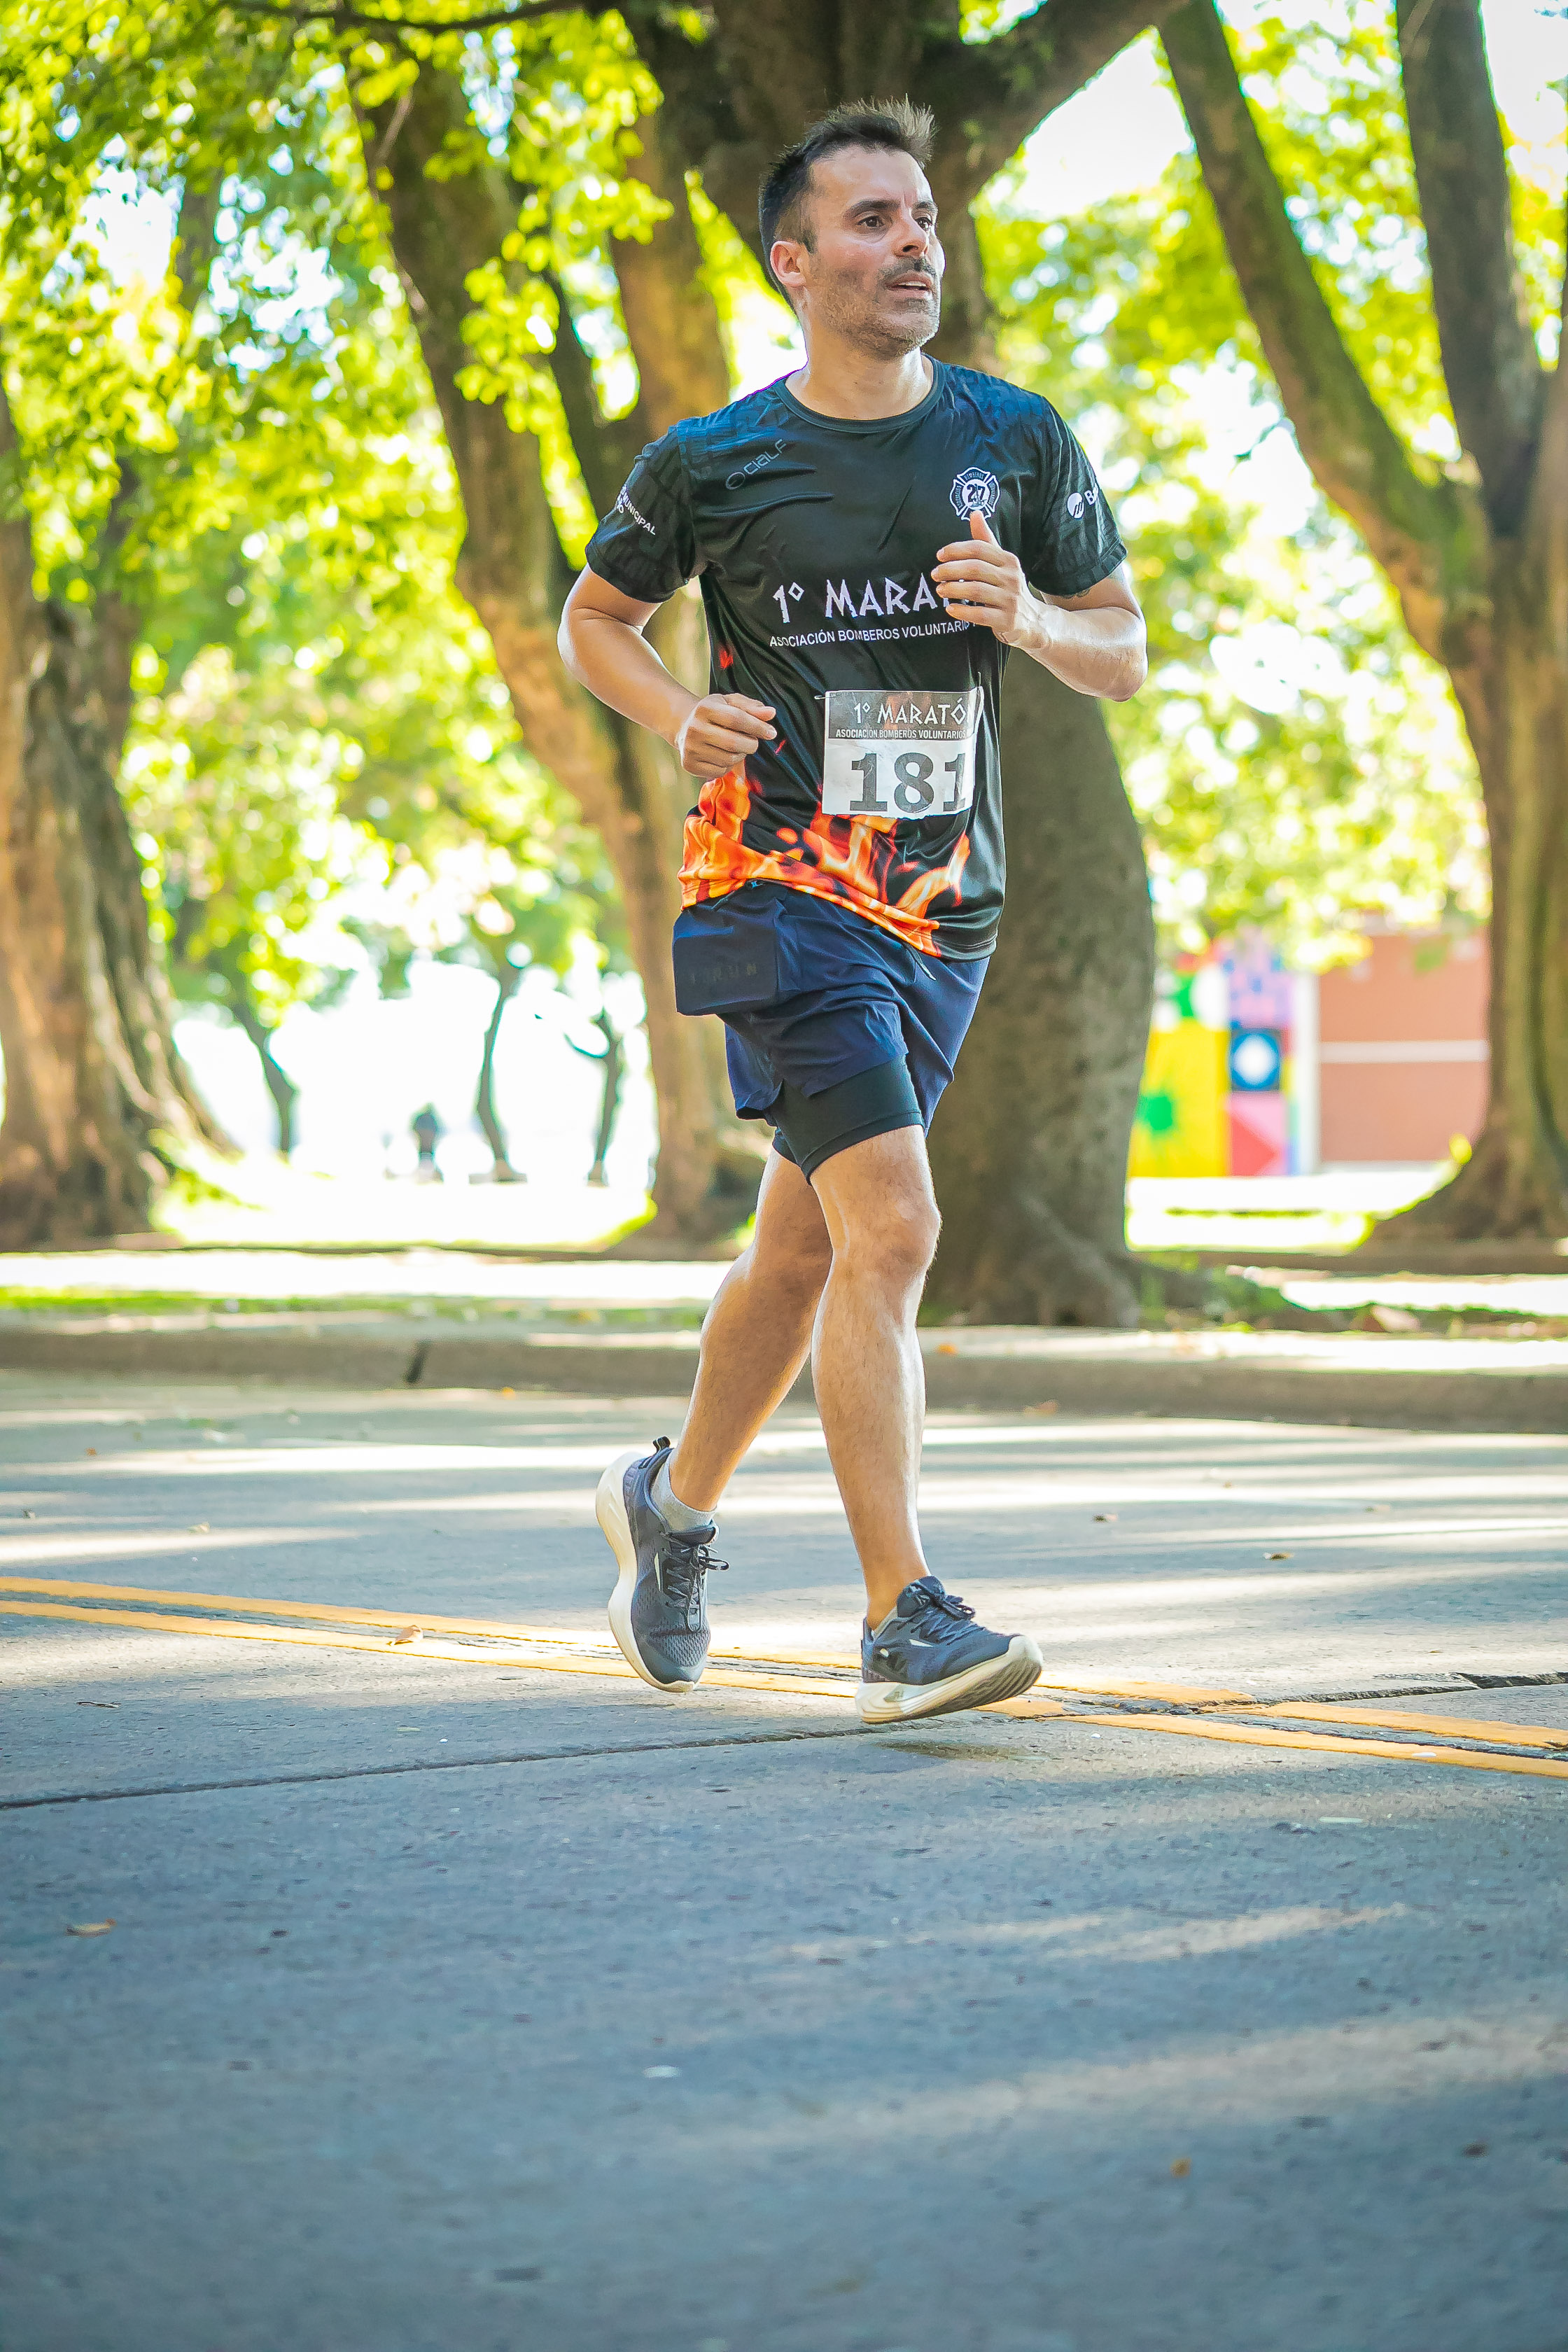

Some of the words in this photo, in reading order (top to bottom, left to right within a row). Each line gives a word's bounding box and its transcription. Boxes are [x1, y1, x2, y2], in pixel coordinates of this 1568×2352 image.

[967, 484, 986, 503] 27
[622, 492, 656, 536] MUNICIPAL
[825, 573, 950, 617] MARA
[769, 629, 836, 648] ASOCIACIÓN
[837, 628, 900, 642] BOMBEROS
[835, 727, 877, 738] ASOCIACIÓN
[879, 729, 917, 739] BOMBEROS
[849, 752, 966, 813] 181
